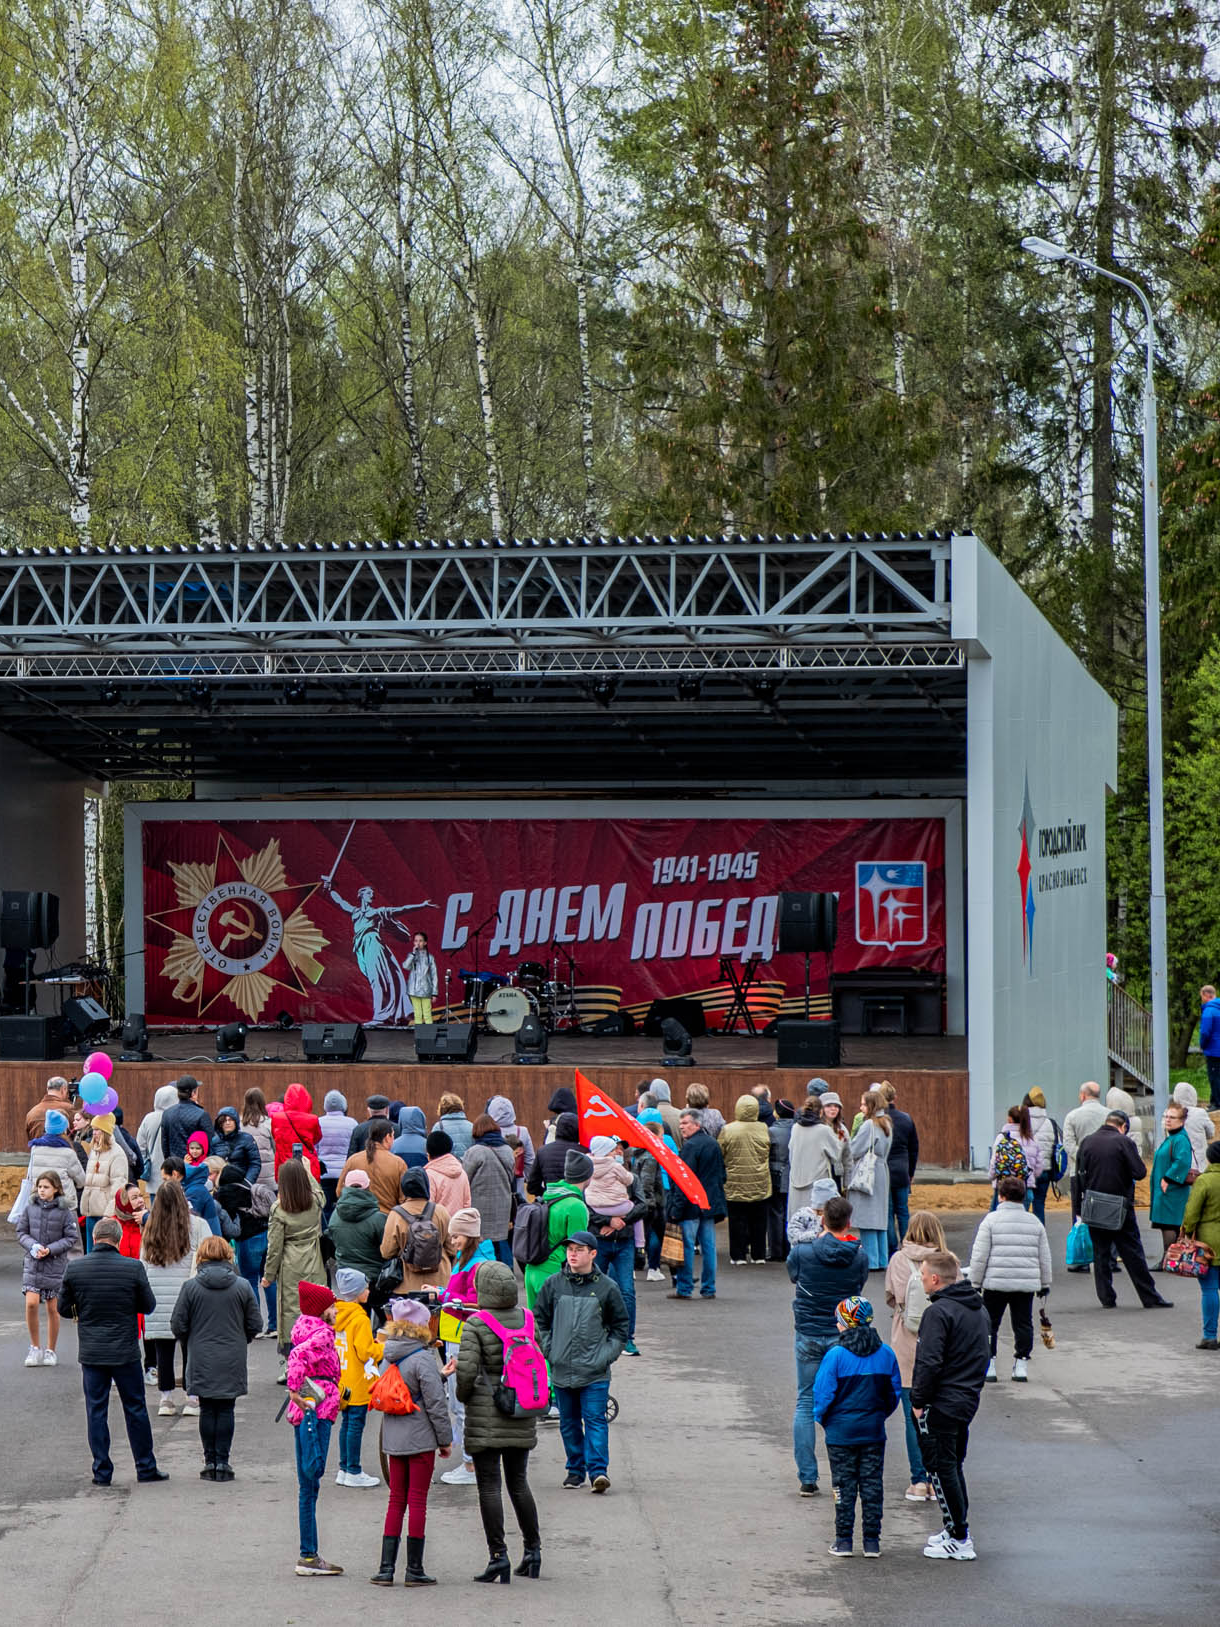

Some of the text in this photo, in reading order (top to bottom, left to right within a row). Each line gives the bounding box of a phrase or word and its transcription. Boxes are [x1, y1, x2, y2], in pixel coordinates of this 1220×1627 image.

[1039, 818, 1087, 859] ГОРОДСКОЙ ПАРК
[652, 852, 759, 884] 1941-1945
[1038, 867, 1087, 893] КРАСНОЗНАМЕНСК
[196, 886, 268, 968] ОТЕЧЕСТВЕННАЯ
[441, 883, 839, 965] С ДНЕМ ПОБЕД
